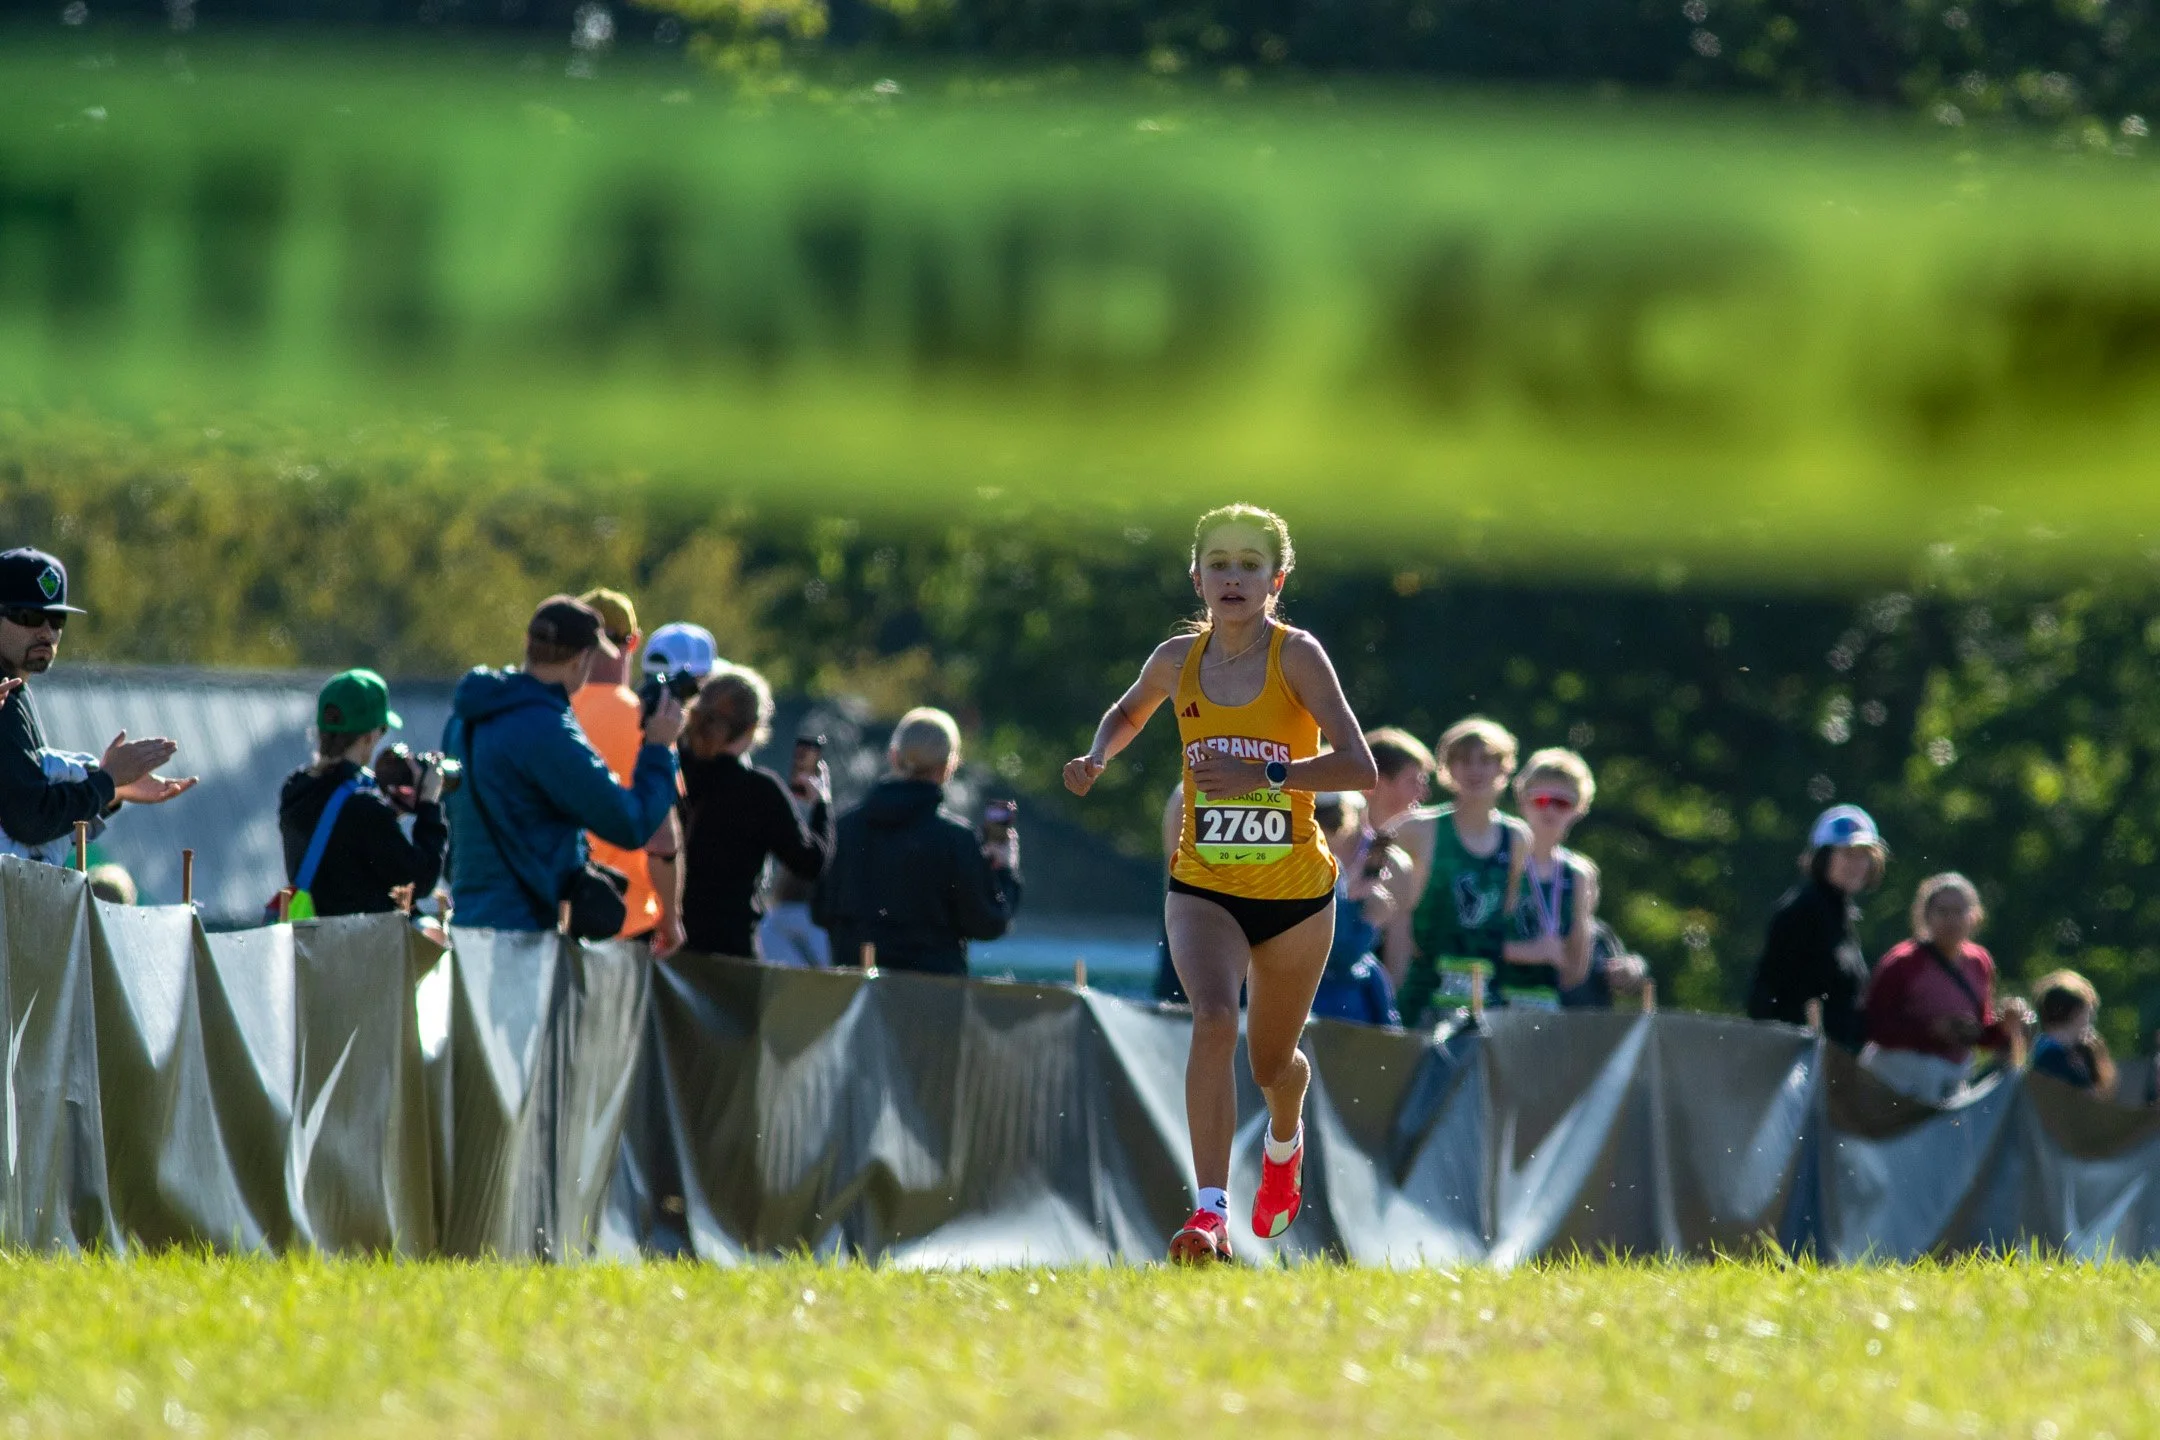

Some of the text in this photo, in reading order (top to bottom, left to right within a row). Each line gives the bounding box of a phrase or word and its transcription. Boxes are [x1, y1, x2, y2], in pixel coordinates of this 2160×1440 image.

[1186, 737, 1291, 767] ST. FRANCIS
[1267, 792, 1281, 803] XC
[1202, 809, 1286, 842] 2760
[1219, 852, 1230, 860] 20
